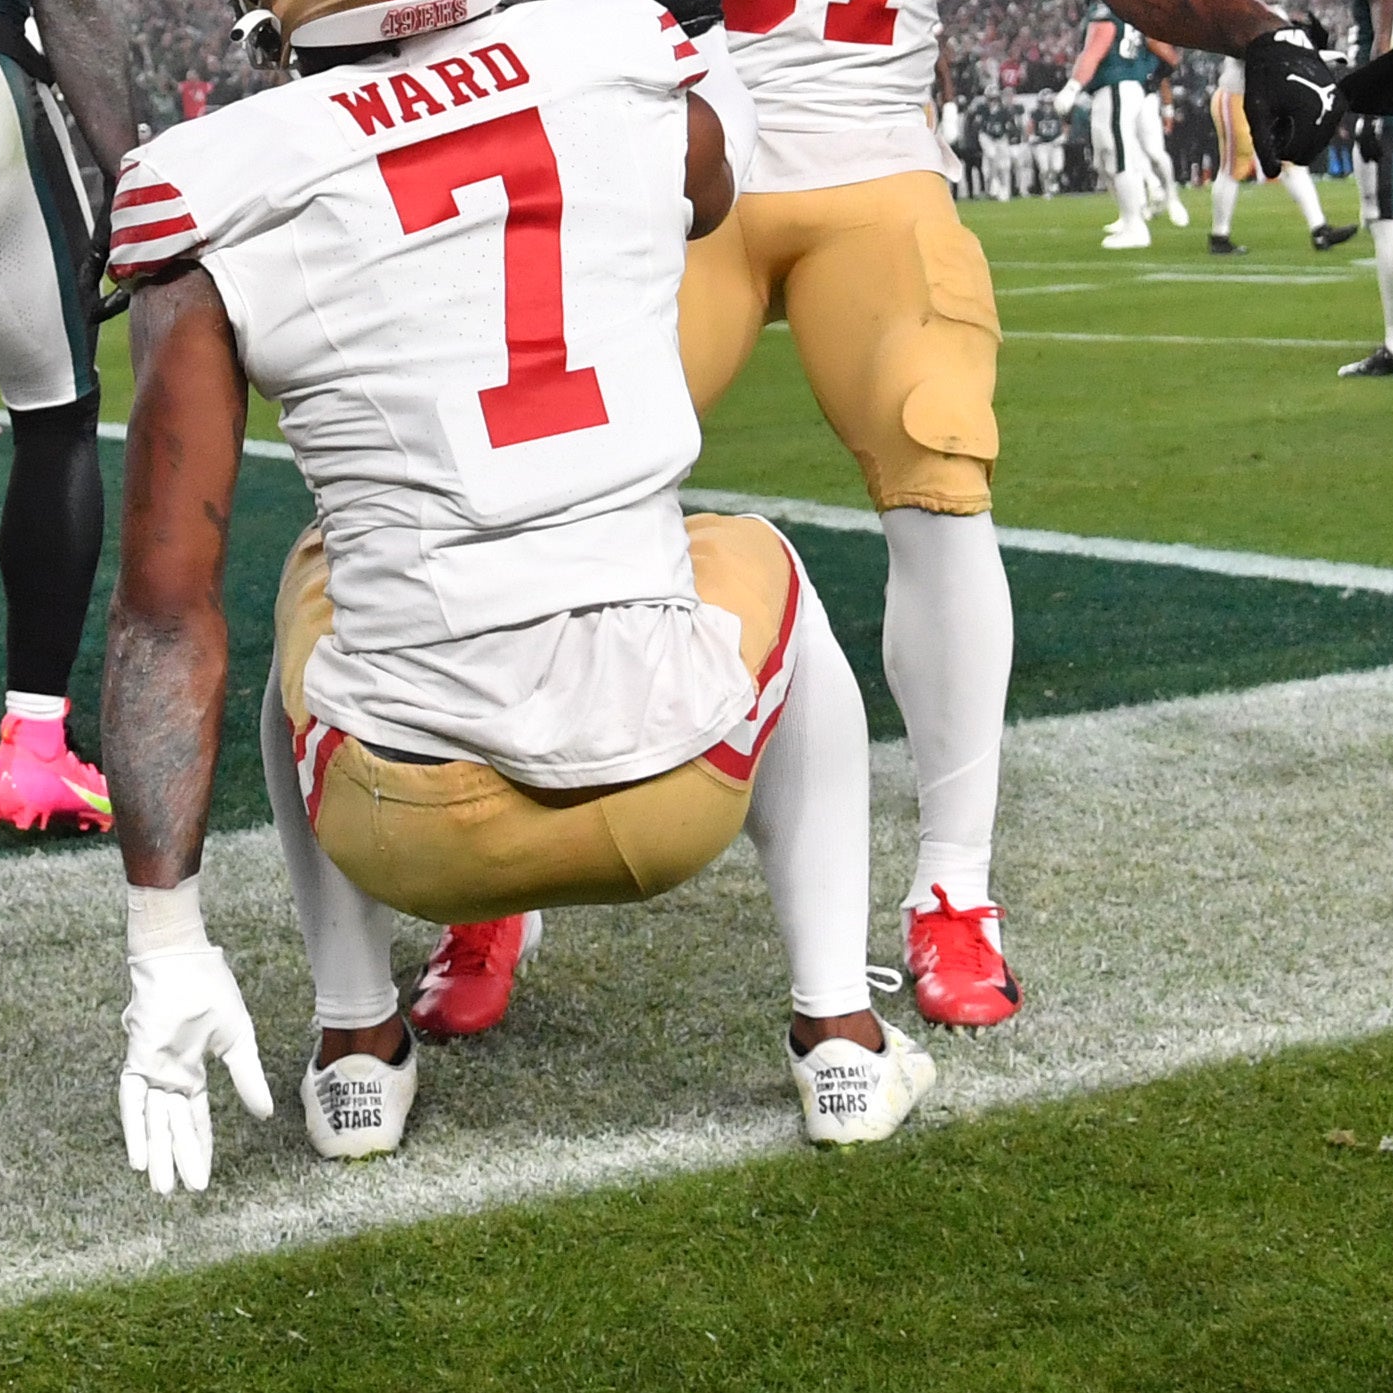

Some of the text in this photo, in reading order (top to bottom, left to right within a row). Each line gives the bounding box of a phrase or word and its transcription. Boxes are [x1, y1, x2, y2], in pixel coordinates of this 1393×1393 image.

[329, 42, 530, 137] WARD
[376, 106, 610, 449] 7
[333, 1108, 382, 1129] STARS
[818, 1094, 867, 1114] STARS
